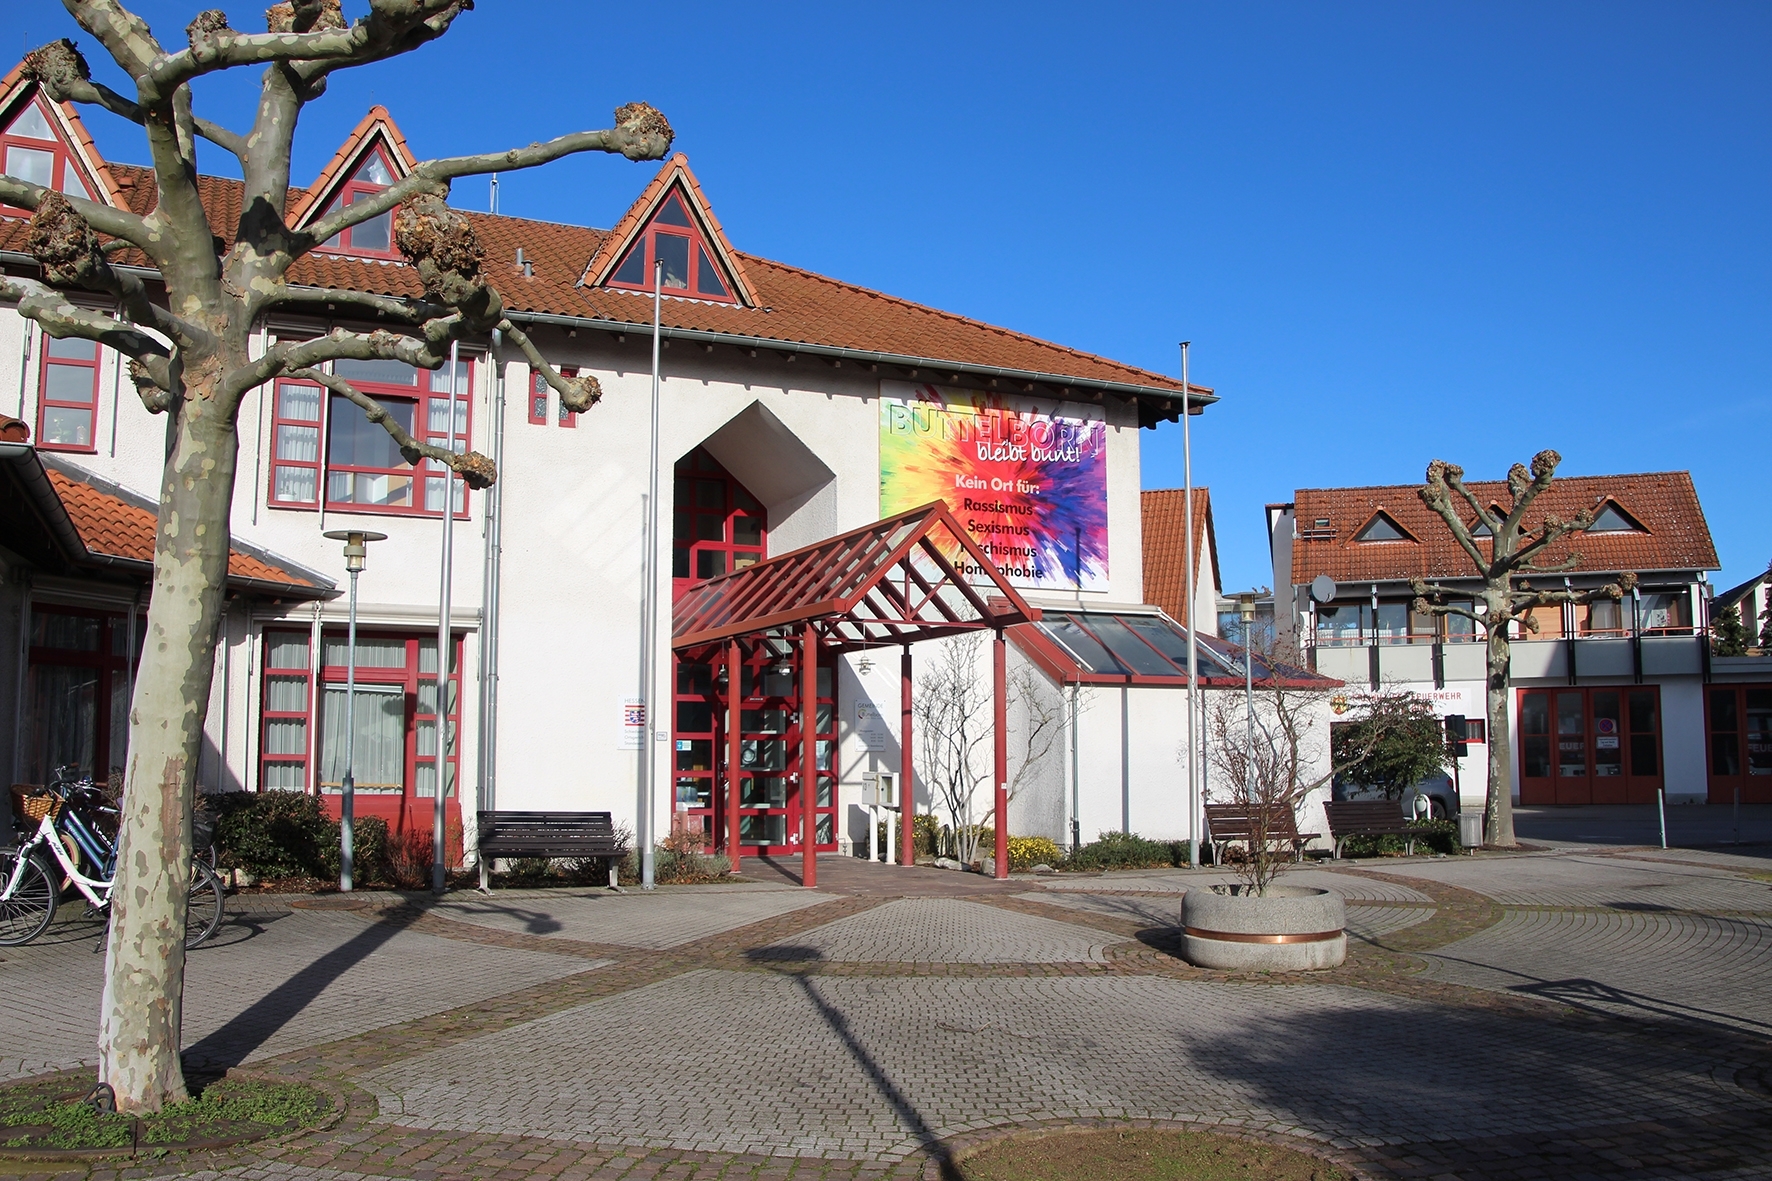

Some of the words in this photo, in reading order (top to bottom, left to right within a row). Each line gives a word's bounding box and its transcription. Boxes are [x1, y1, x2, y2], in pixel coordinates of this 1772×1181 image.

[889, 399, 1099, 454] BÜTTELBORN
[976, 440, 1027, 462] bleibt
[1031, 445, 1081, 463] bunt!
[955, 474, 987, 490] Kein
[990, 477, 1014, 492] Ort
[1016, 479, 1040, 495] für:
[963, 498, 1033, 516] Rassismus
[967, 519, 1030, 536] Sexismus
[960, 541, 1037, 557] schismus
[954, 561, 1043, 578] Homphobie
